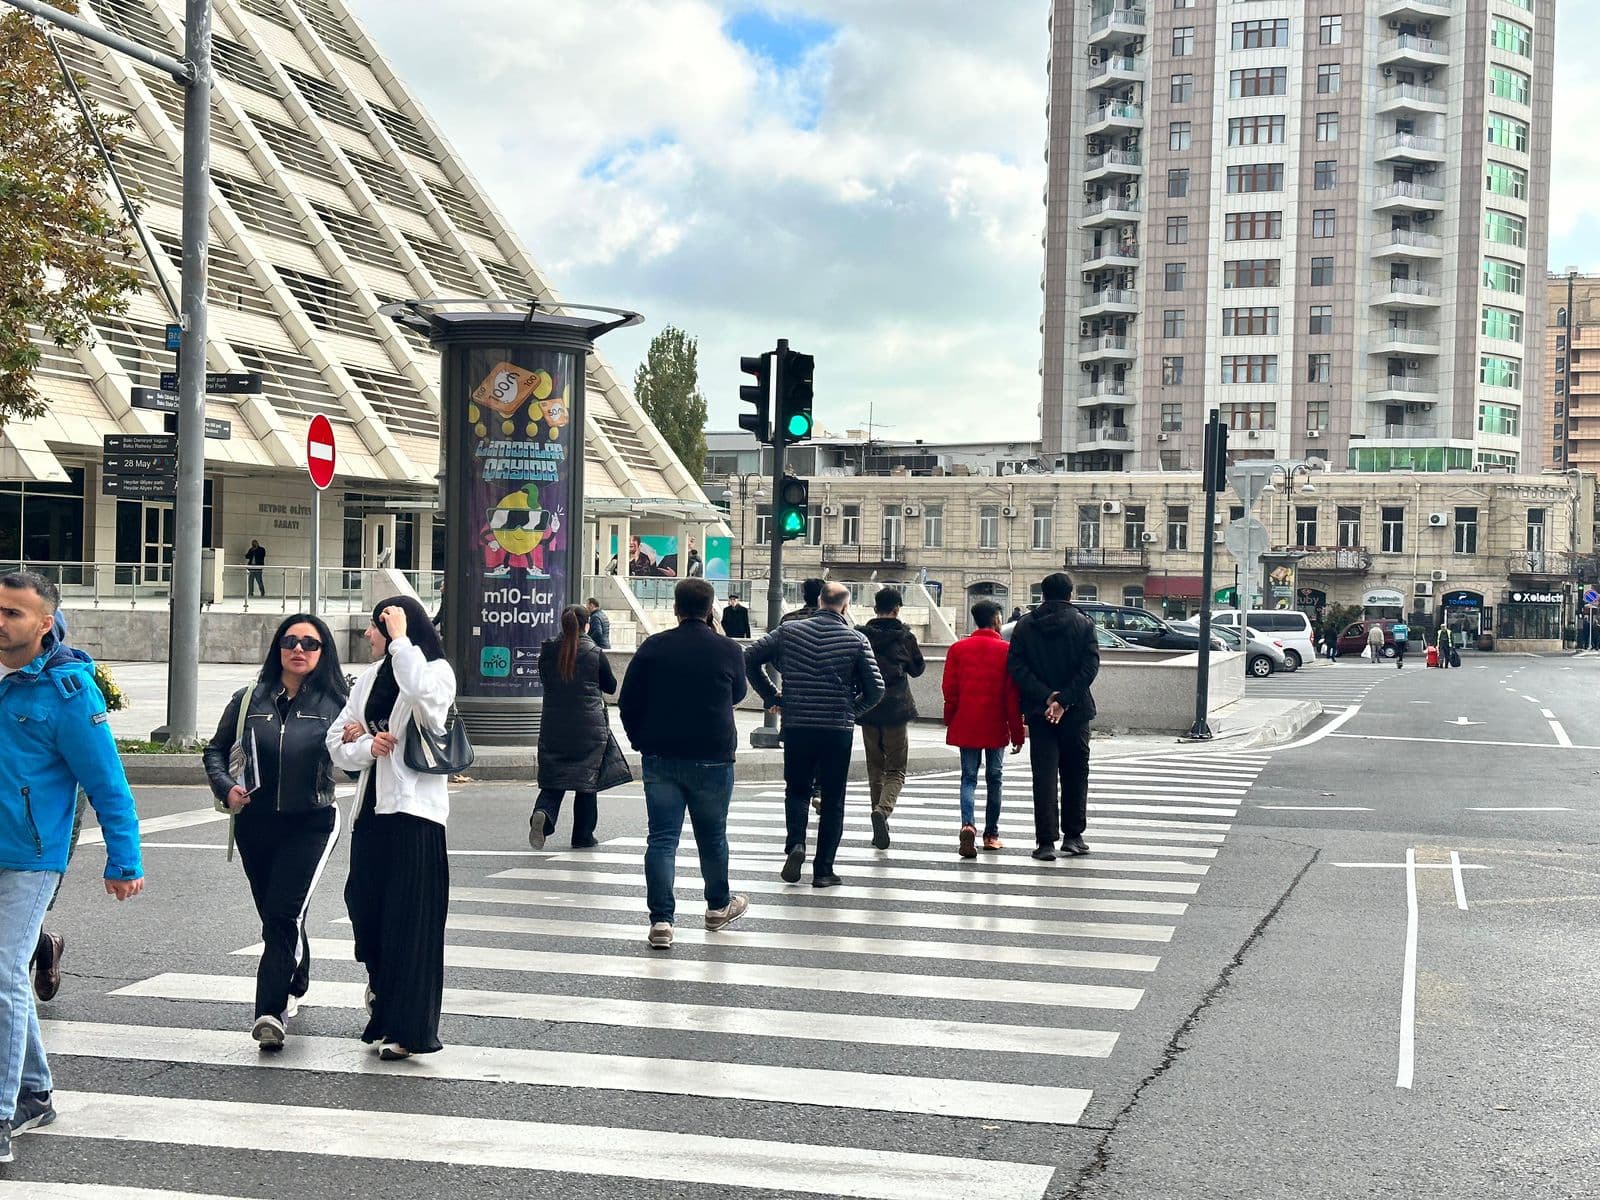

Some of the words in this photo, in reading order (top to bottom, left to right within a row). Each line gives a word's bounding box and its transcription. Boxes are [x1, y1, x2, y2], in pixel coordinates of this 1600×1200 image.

[124, 459, 134, 468] 28
[135, 459, 151, 470] May
[484, 588, 553, 605] m10-lar
[481, 607, 554, 628] toplayır!
